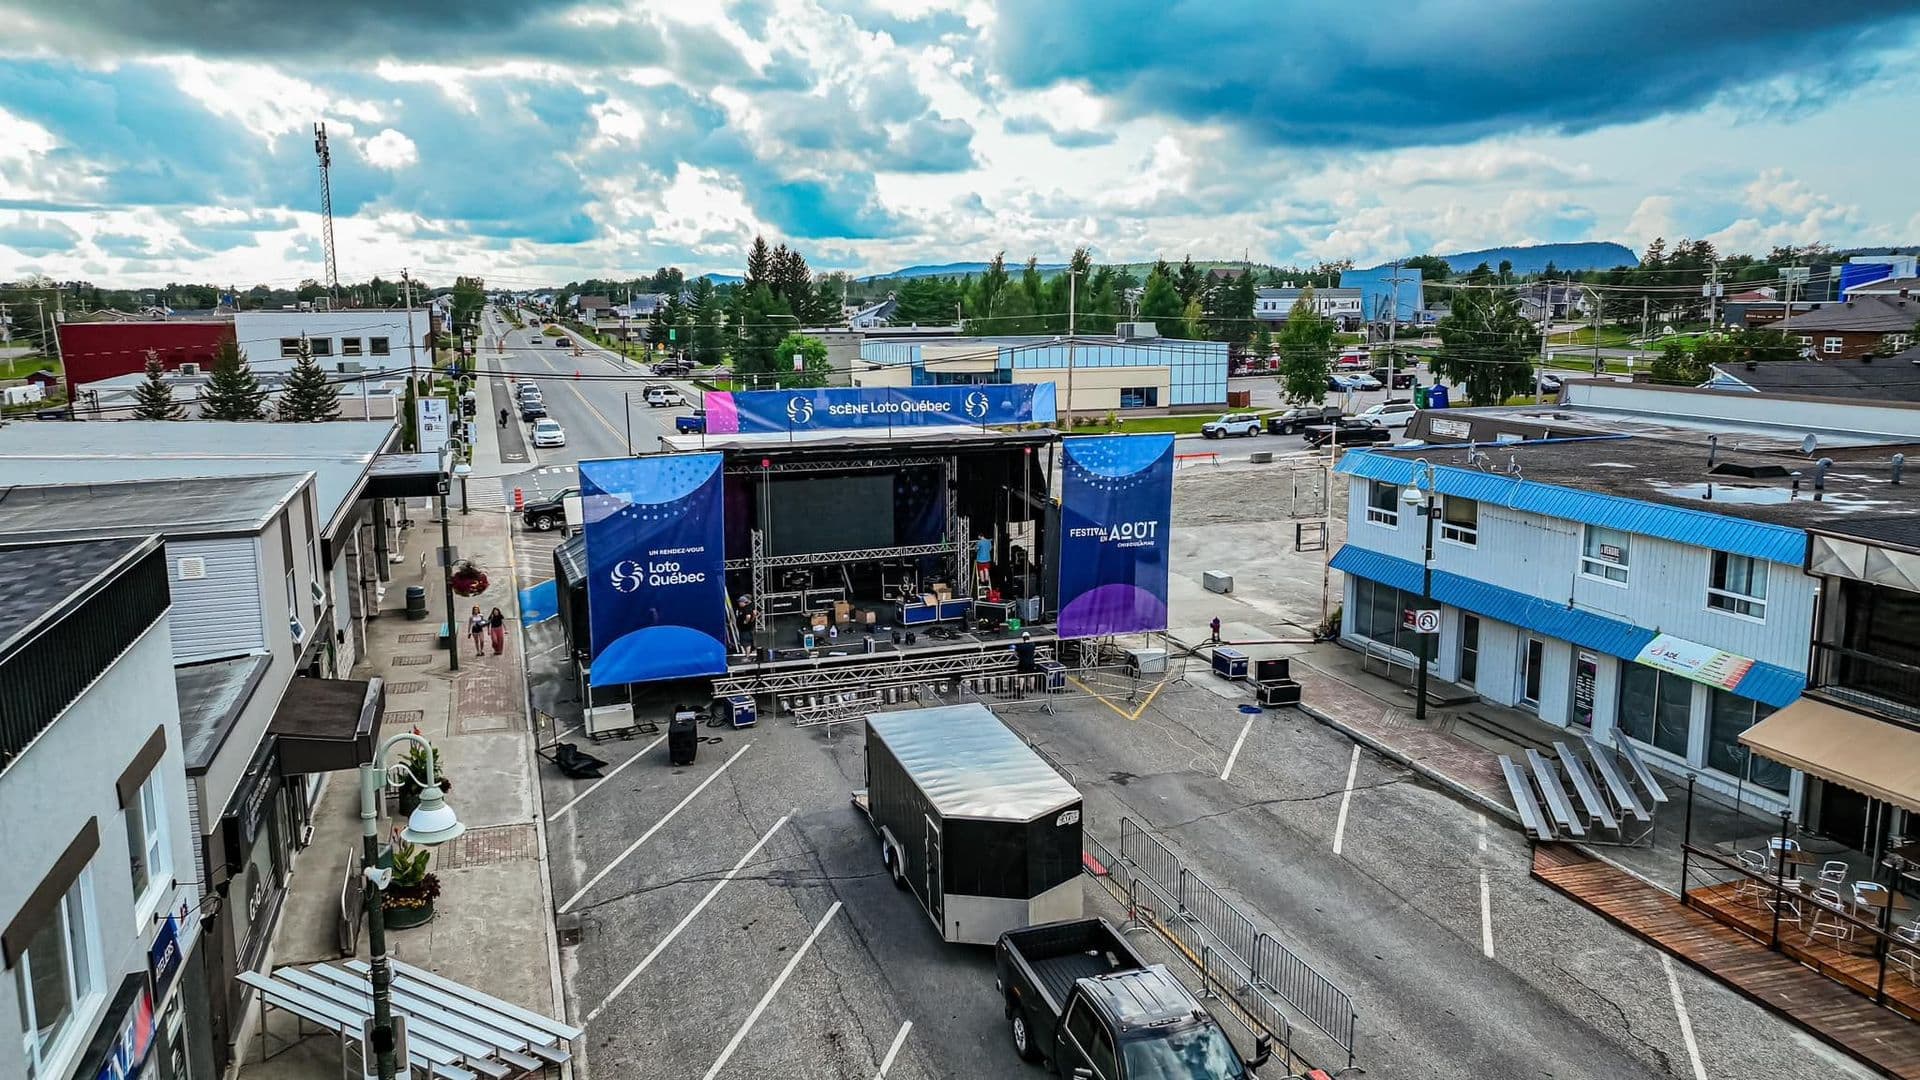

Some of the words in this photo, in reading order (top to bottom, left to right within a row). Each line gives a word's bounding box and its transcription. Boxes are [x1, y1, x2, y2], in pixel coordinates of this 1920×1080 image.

[828, 403, 868, 415] SCÈNE
[870, 401, 898, 413] Loto
[899, 399, 951, 413] Québec
[1070, 528, 1108, 538] FESTIVAL
[660, 546, 704, 554] RENDEZ-VOUS
[649, 561, 680, 573] Loto
[649, 572, 705, 586] Québec
